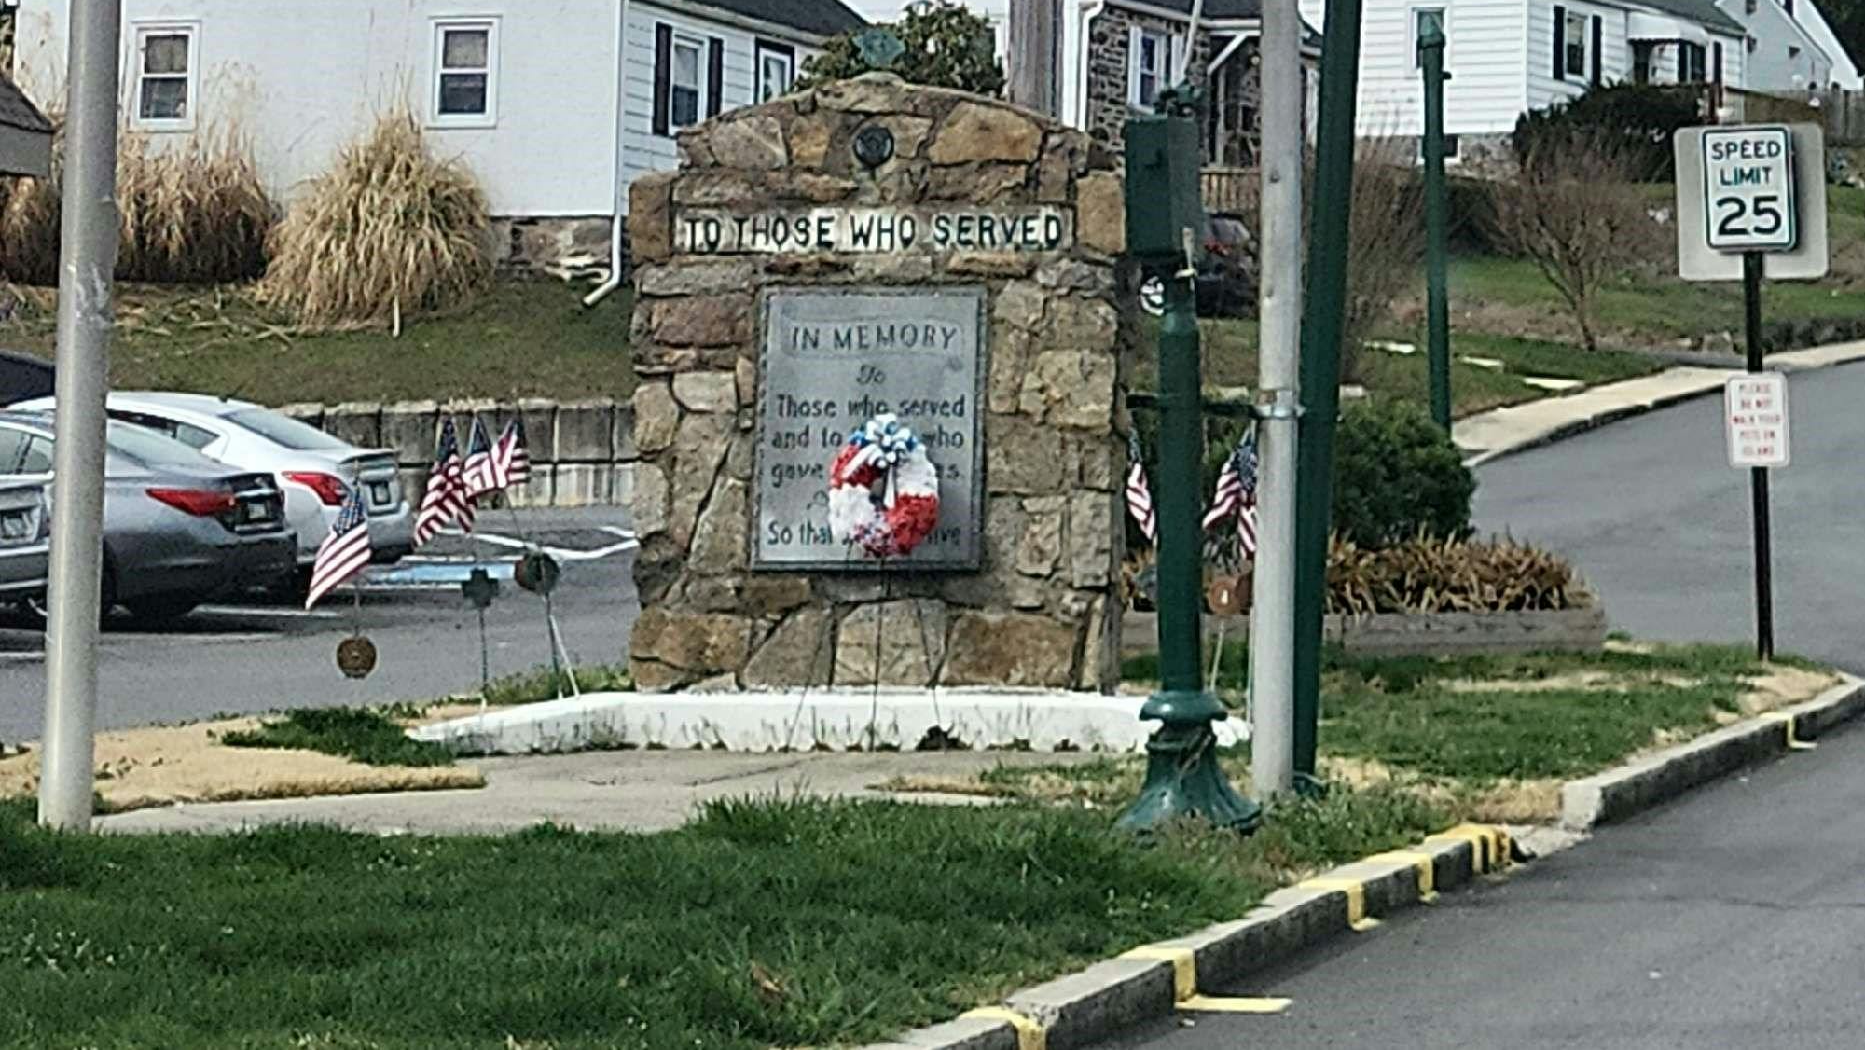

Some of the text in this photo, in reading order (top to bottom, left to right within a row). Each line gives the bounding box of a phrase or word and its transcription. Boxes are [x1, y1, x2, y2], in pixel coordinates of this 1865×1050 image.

[1711, 140, 1782, 160] SPEED
[1719, 166, 1773, 186] LIMIT
[1716, 195, 1782, 236] 25
[684, 214, 1062, 251] TO THOSE WHO SERVED
[792, 324, 957, 350] IN MEMORY
[777, 393, 966, 419] Those who served
[771, 424, 810, 449] and
[920, 424, 964, 449] who
[771, 463, 824, 489] gave
[767, 520, 793, 546] So
